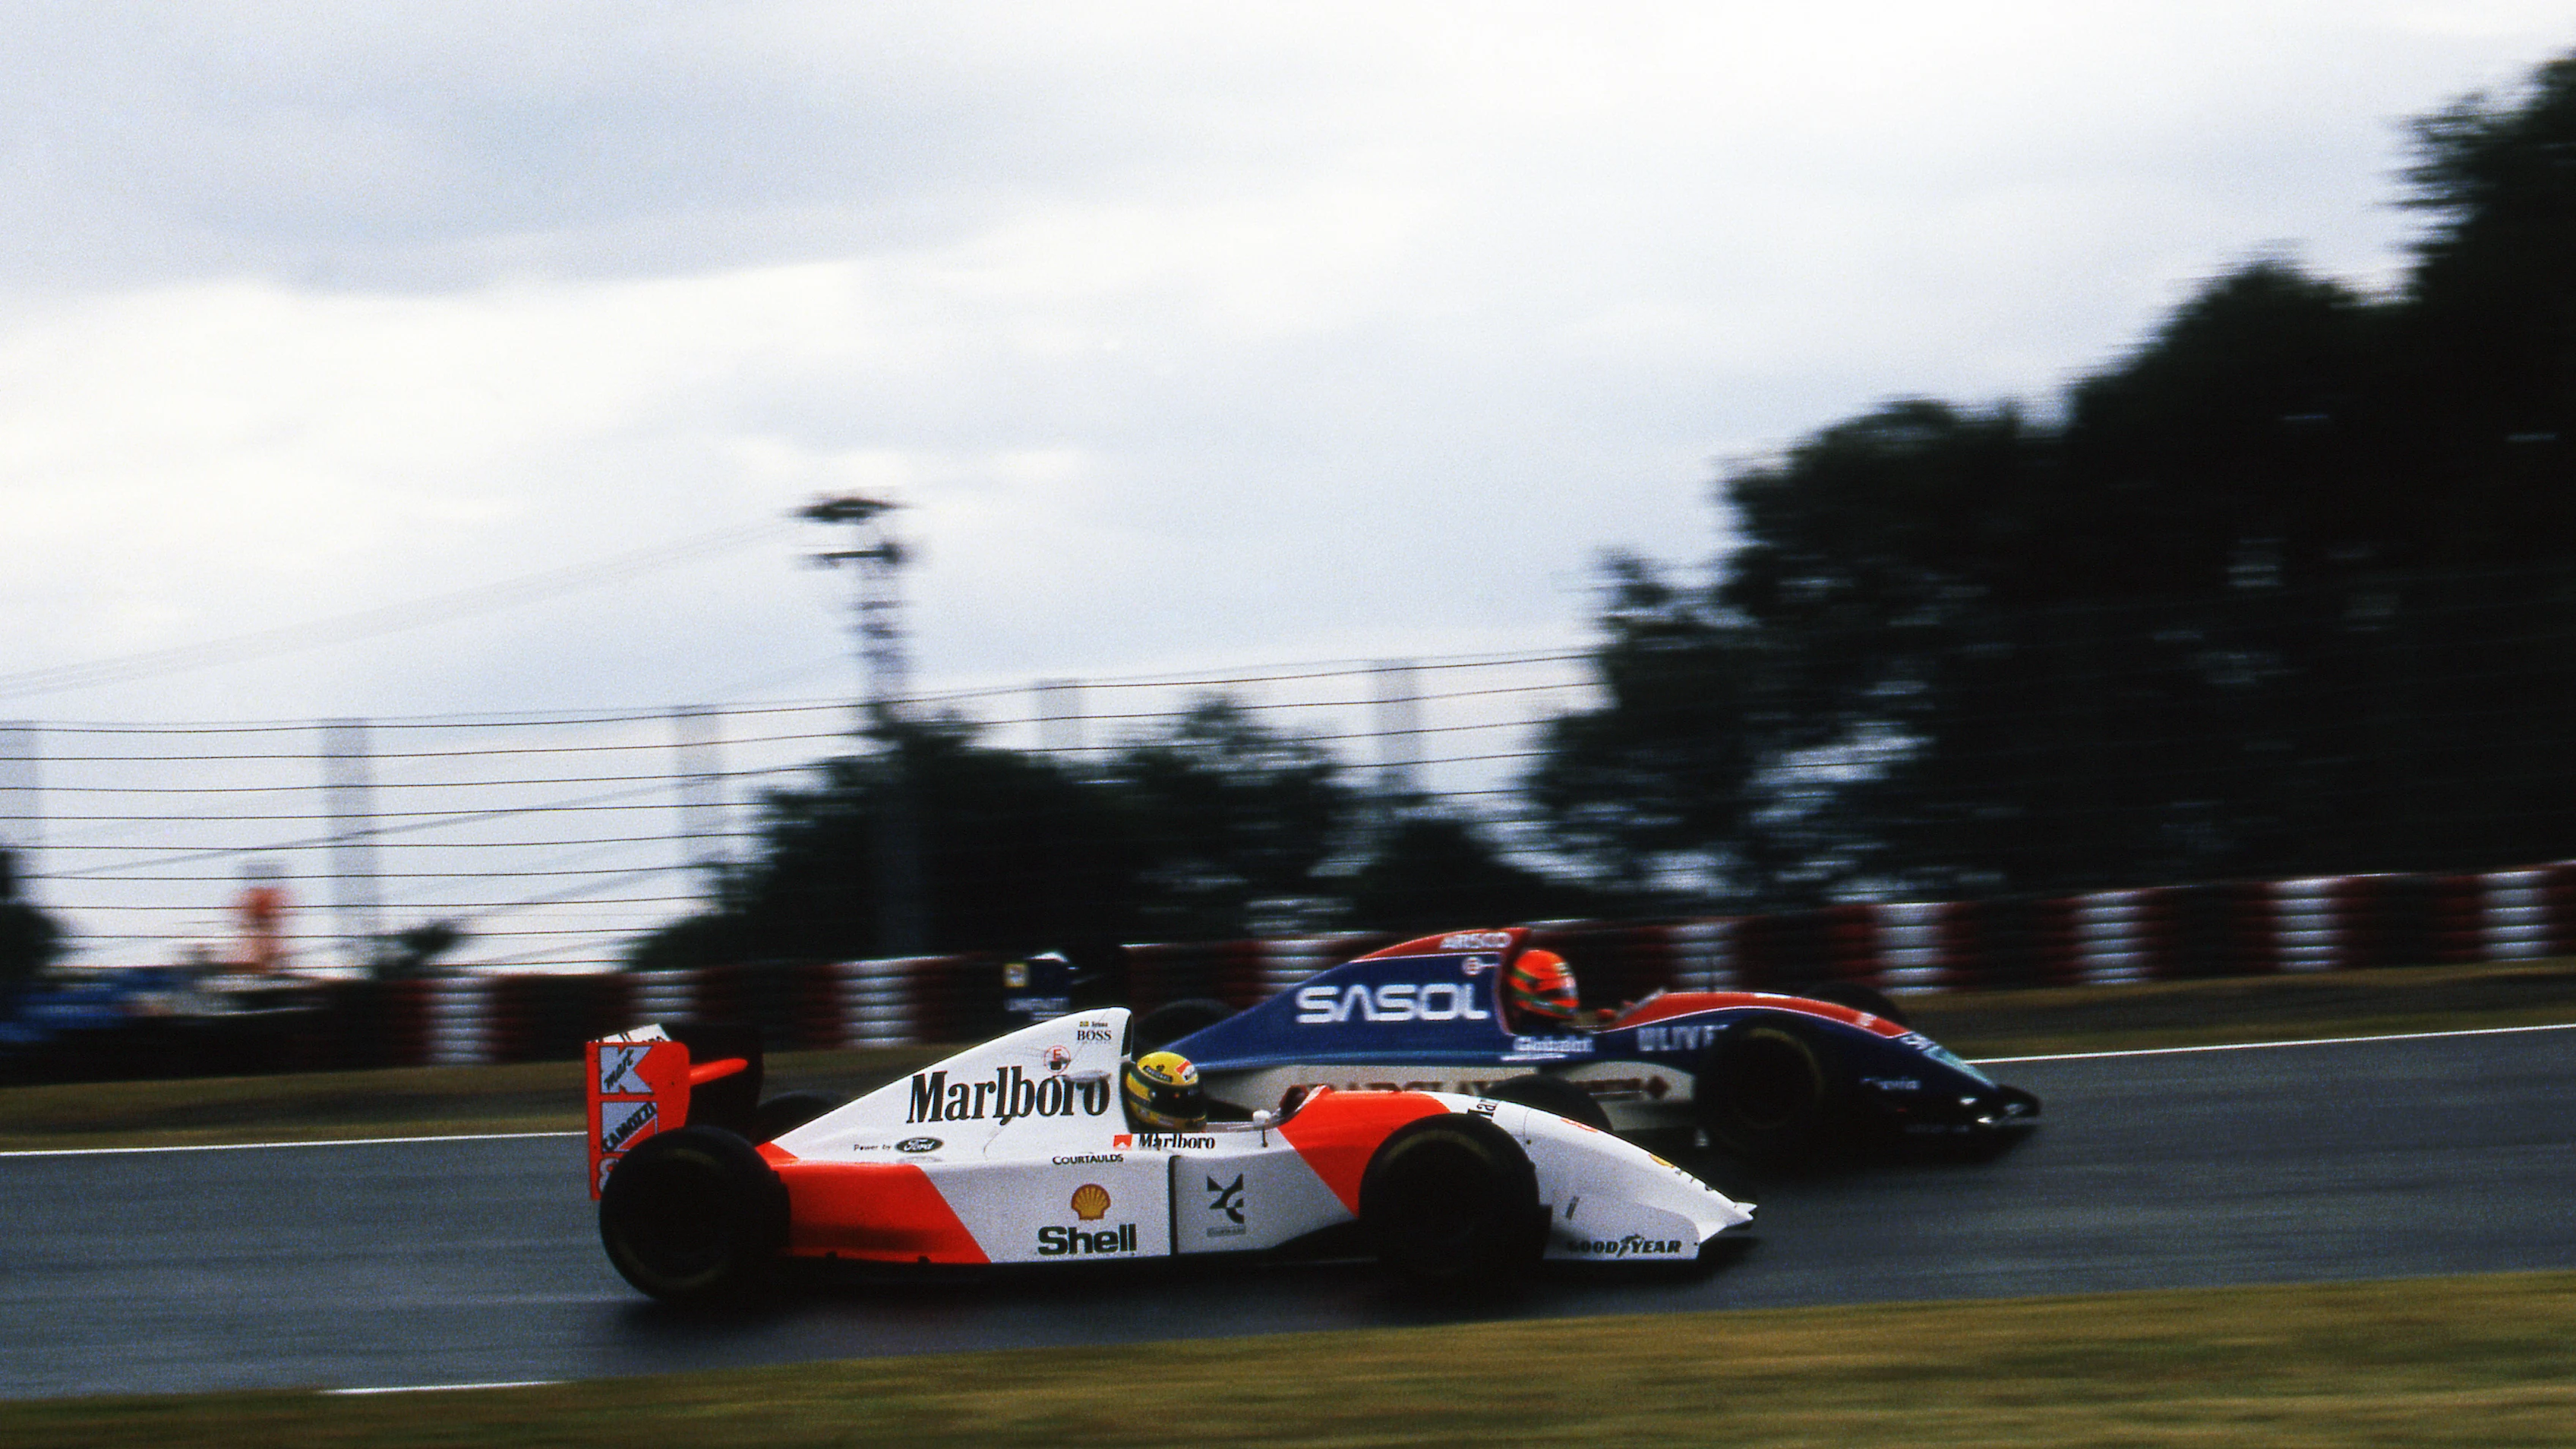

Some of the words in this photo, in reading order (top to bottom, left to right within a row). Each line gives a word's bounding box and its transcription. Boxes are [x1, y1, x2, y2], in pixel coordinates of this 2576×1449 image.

[1296, 983, 1491, 1023] SASOL
[1077, 1030, 1112, 1040] BOSS
[598, 1045, 655, 1095] K
[906, 1065, 1110, 1124] Marlboro
[1138, 1133, 1215, 1151] Marlboro
[1037, 1223, 1137, 1255] Shell
